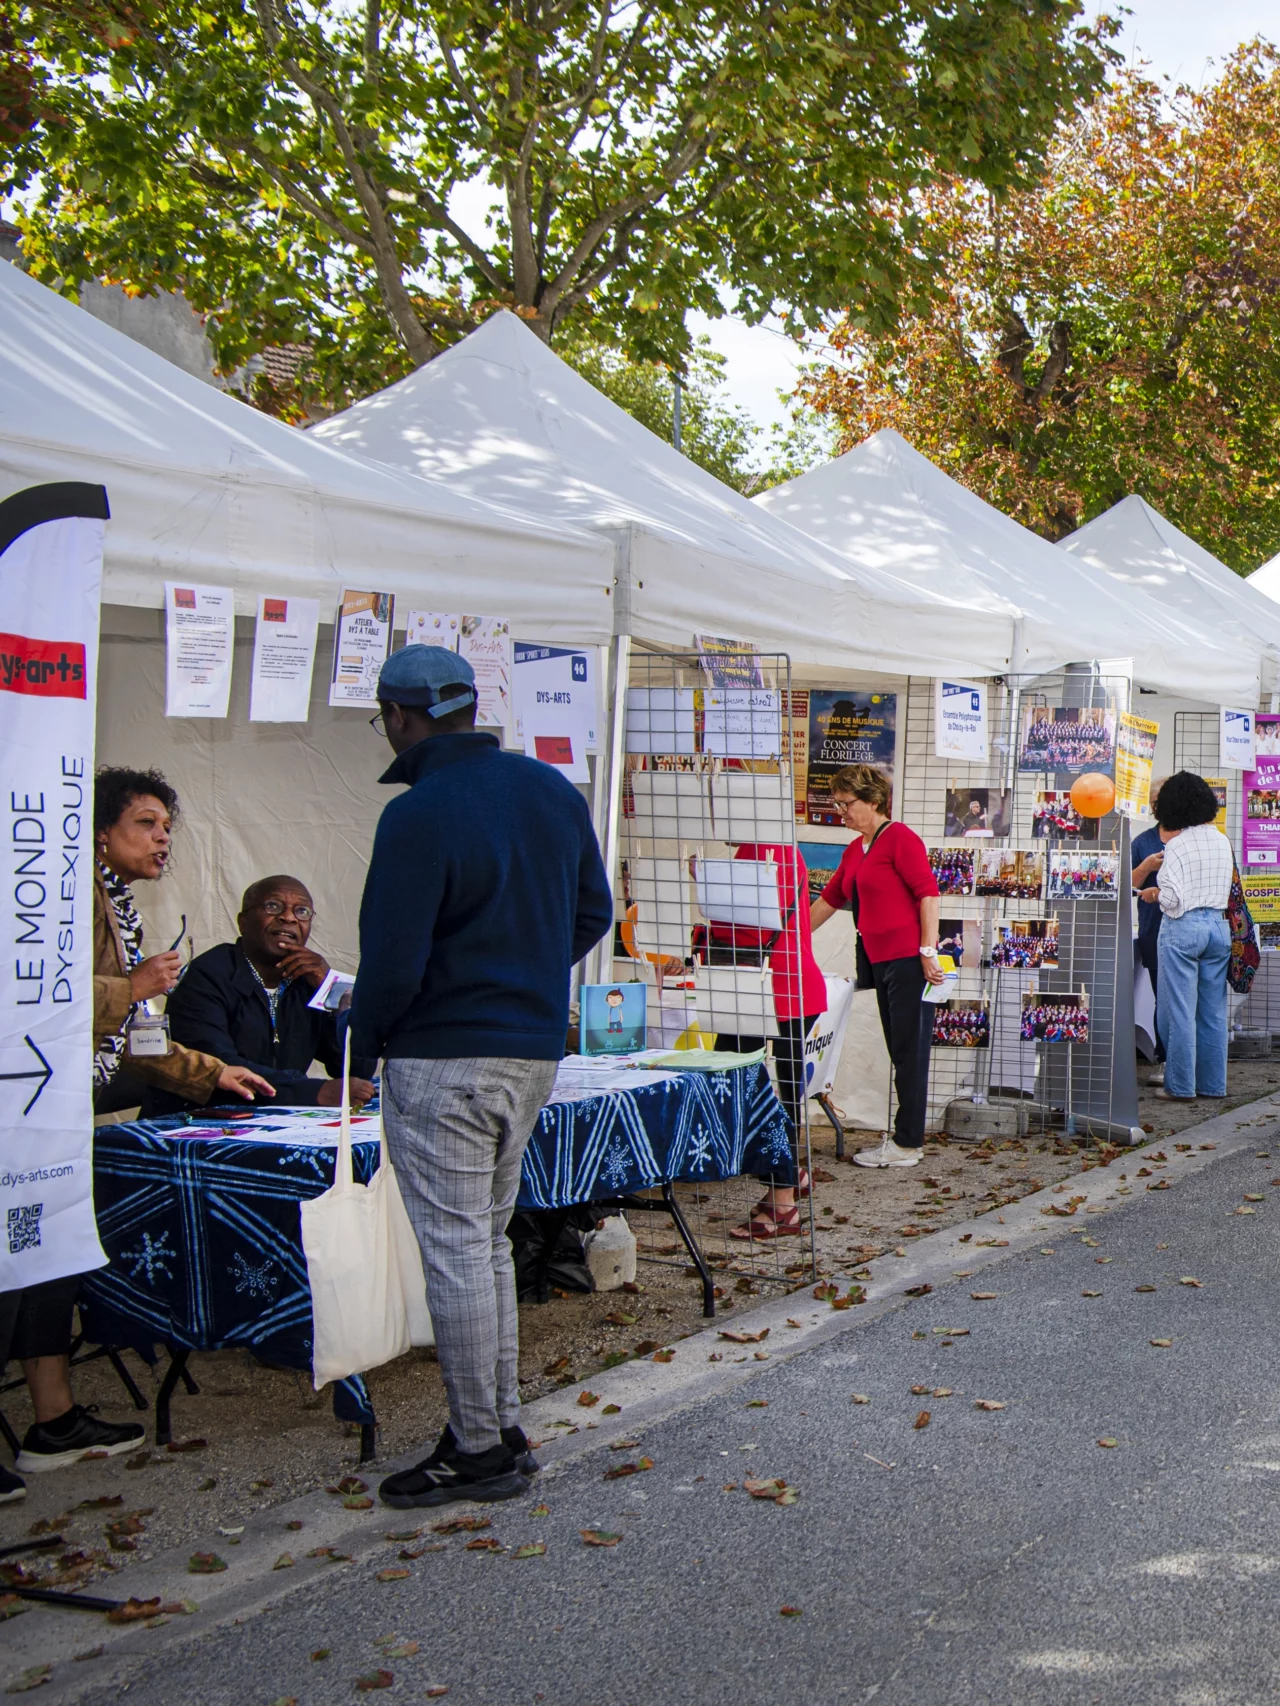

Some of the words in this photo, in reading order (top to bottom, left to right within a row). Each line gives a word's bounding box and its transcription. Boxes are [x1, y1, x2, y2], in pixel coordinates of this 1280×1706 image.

[354, 618, 373, 627] ATELIER
[365, 628, 380, 636] TABLE
[573, 663, 585, 676] 46
[536, 690, 572, 705] DYS-ARTS
[817, 716, 826, 724] 40
[826, 716, 841, 724] ANS
[842, 716, 852, 724] DE
[852, 718, 885, 726] MUSIQUE
[942, 709, 958, 719] Ensemble
[958, 711, 982, 723] Polyphonique
[948, 722, 952, 730] de
[823, 739, 873, 751] CONCERT
[820, 749, 875, 762] FLORILEGE
[1257, 764, 1276, 776] Un
[1257, 775, 1274, 786] de
[11, 791, 46, 944] MONDE
[52, 755, 84, 1004] DYSLEXIQUE
[16, 958, 44, 1005] LE
